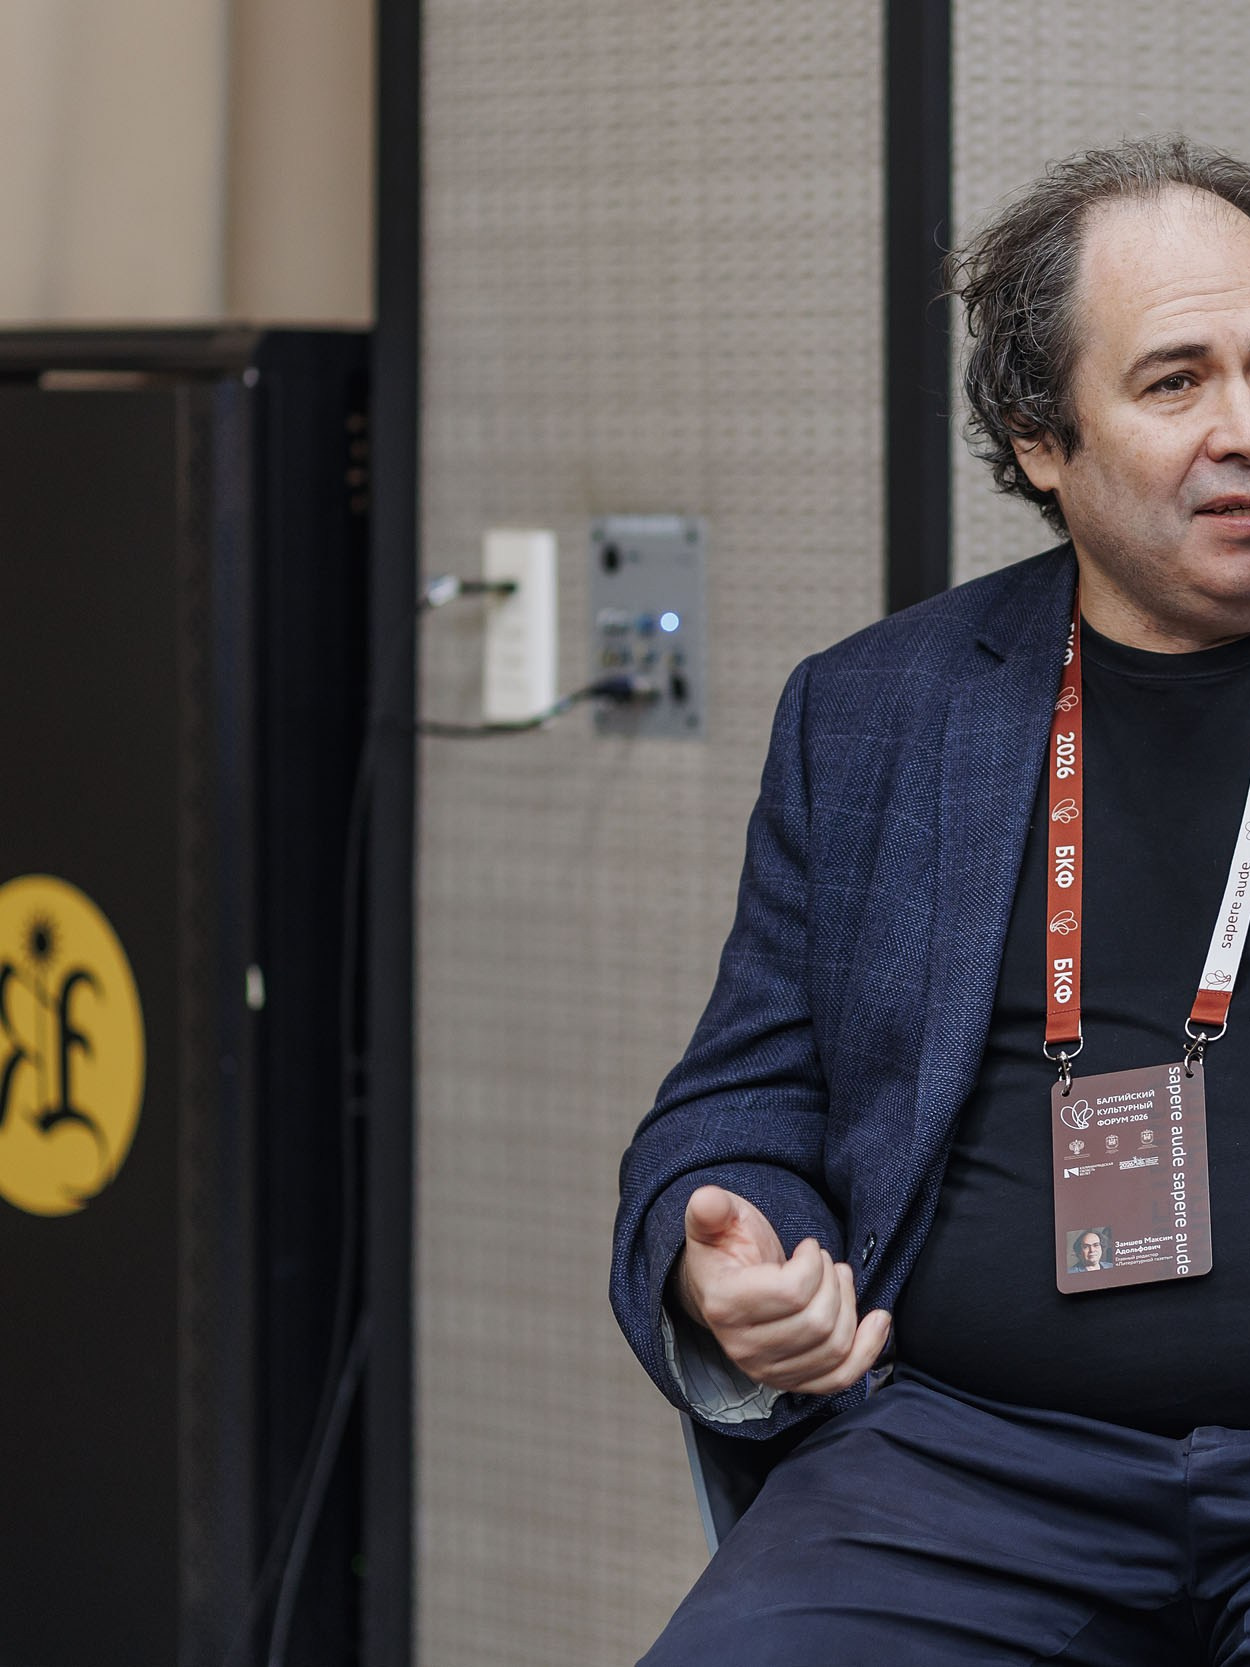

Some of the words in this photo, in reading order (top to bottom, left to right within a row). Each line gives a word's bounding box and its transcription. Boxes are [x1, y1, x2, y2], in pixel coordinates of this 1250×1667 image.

[1056, 731, 1076, 780] 2026
[1054, 845, 1075, 889] БКФ
[1221, 901, 1242, 950] sapere
[1053, 957, 1073, 1005] БКФ
[1096, 1089, 1155, 1105] БАЛТИЙСКИЙ
[1096, 1100, 1153, 1116] КУЛЬТУРНЫЙ
[1166, 1066, 1183, 1121] sapere
[1096, 1116, 1129, 1127] ФОРУМ
[1129, 1113, 1149, 1122] 2026
[1171, 1126, 1187, 1168] aude
[1170, 1172, 1187, 1228] sapere
[1114, 1240, 1143, 1248] Замшев
[1143, 1235, 1173, 1244] Максим
[1114, 1244, 1161, 1255] Адольфович
[1175, 1233, 1192, 1275] aude
